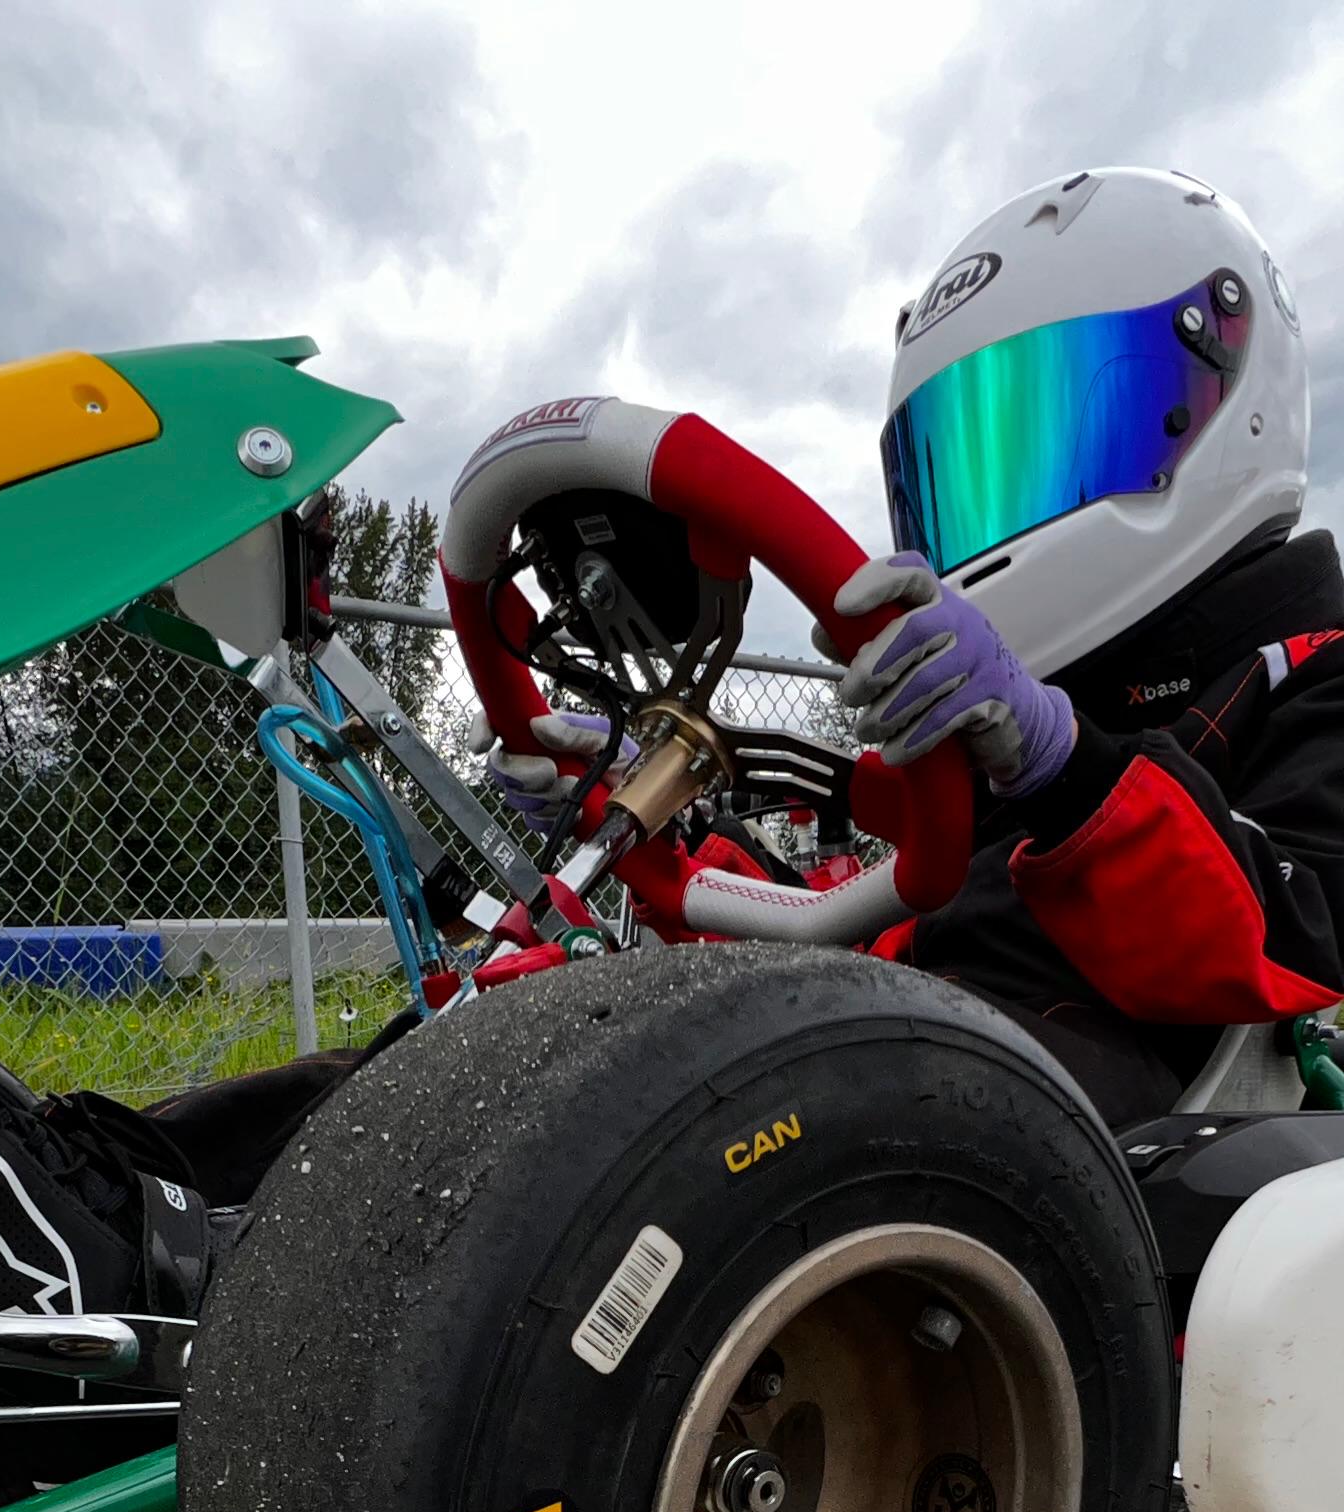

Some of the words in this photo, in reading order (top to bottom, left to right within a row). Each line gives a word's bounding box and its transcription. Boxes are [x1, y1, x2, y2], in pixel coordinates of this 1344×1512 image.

[919, 255, 986, 321] Arai
[1126, 678, 1191, 705] Xbase
[725, 1112, 801, 1173] CAN
